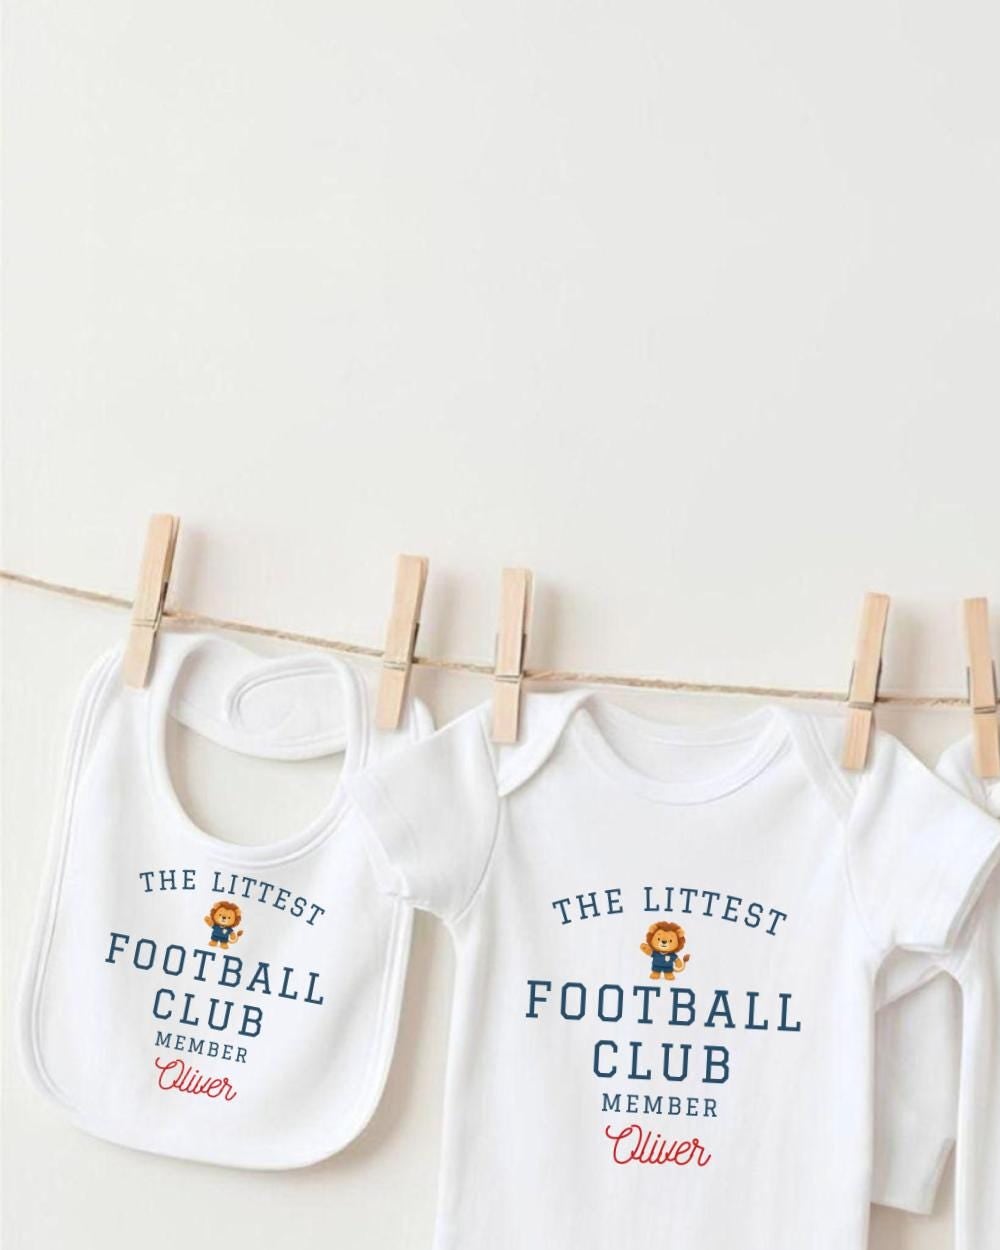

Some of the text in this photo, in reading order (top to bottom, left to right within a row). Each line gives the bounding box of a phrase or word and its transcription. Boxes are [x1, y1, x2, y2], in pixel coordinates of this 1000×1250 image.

[140, 870, 325, 926] THE LITTEST
[552, 887, 787, 936] THE LITTEST
[105, 932, 324, 1005] FOOTBALL
[153, 988, 263, 1037] CLUB
[525, 980, 801, 1032] FOOTBALL
[155, 1031, 247, 1063] MEMBER
[593, 1040, 729, 1084] CLUB
[155, 1057, 236, 1102] Oliver
[602, 1093, 717, 1117] MEMBER
[605, 1124, 712, 1167] Oliver
